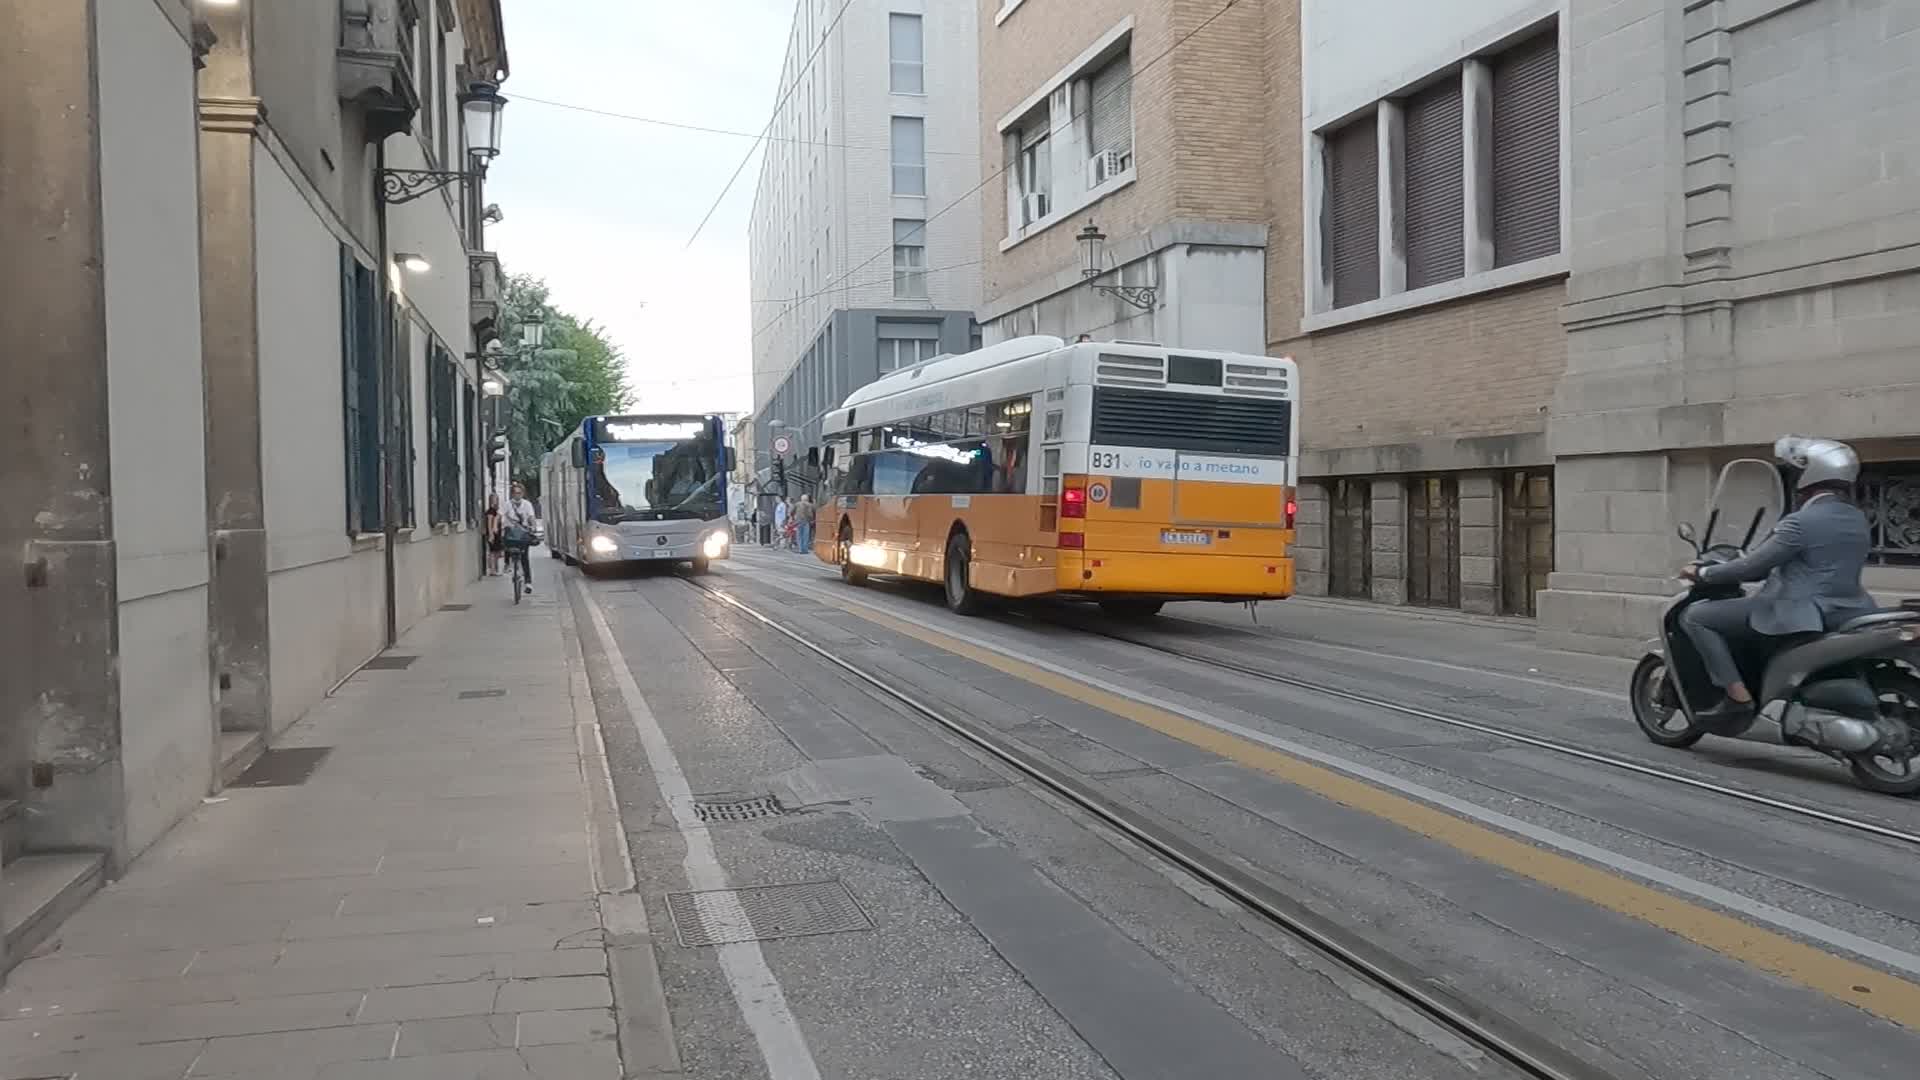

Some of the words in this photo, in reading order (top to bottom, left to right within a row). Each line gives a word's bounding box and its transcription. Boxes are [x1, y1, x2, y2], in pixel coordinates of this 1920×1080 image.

[1092, 452, 1120, 469] 831
[1139, 456, 1152, 469] io
[1193, 462, 1202, 472] a
[1206, 463, 1259, 475] metano
